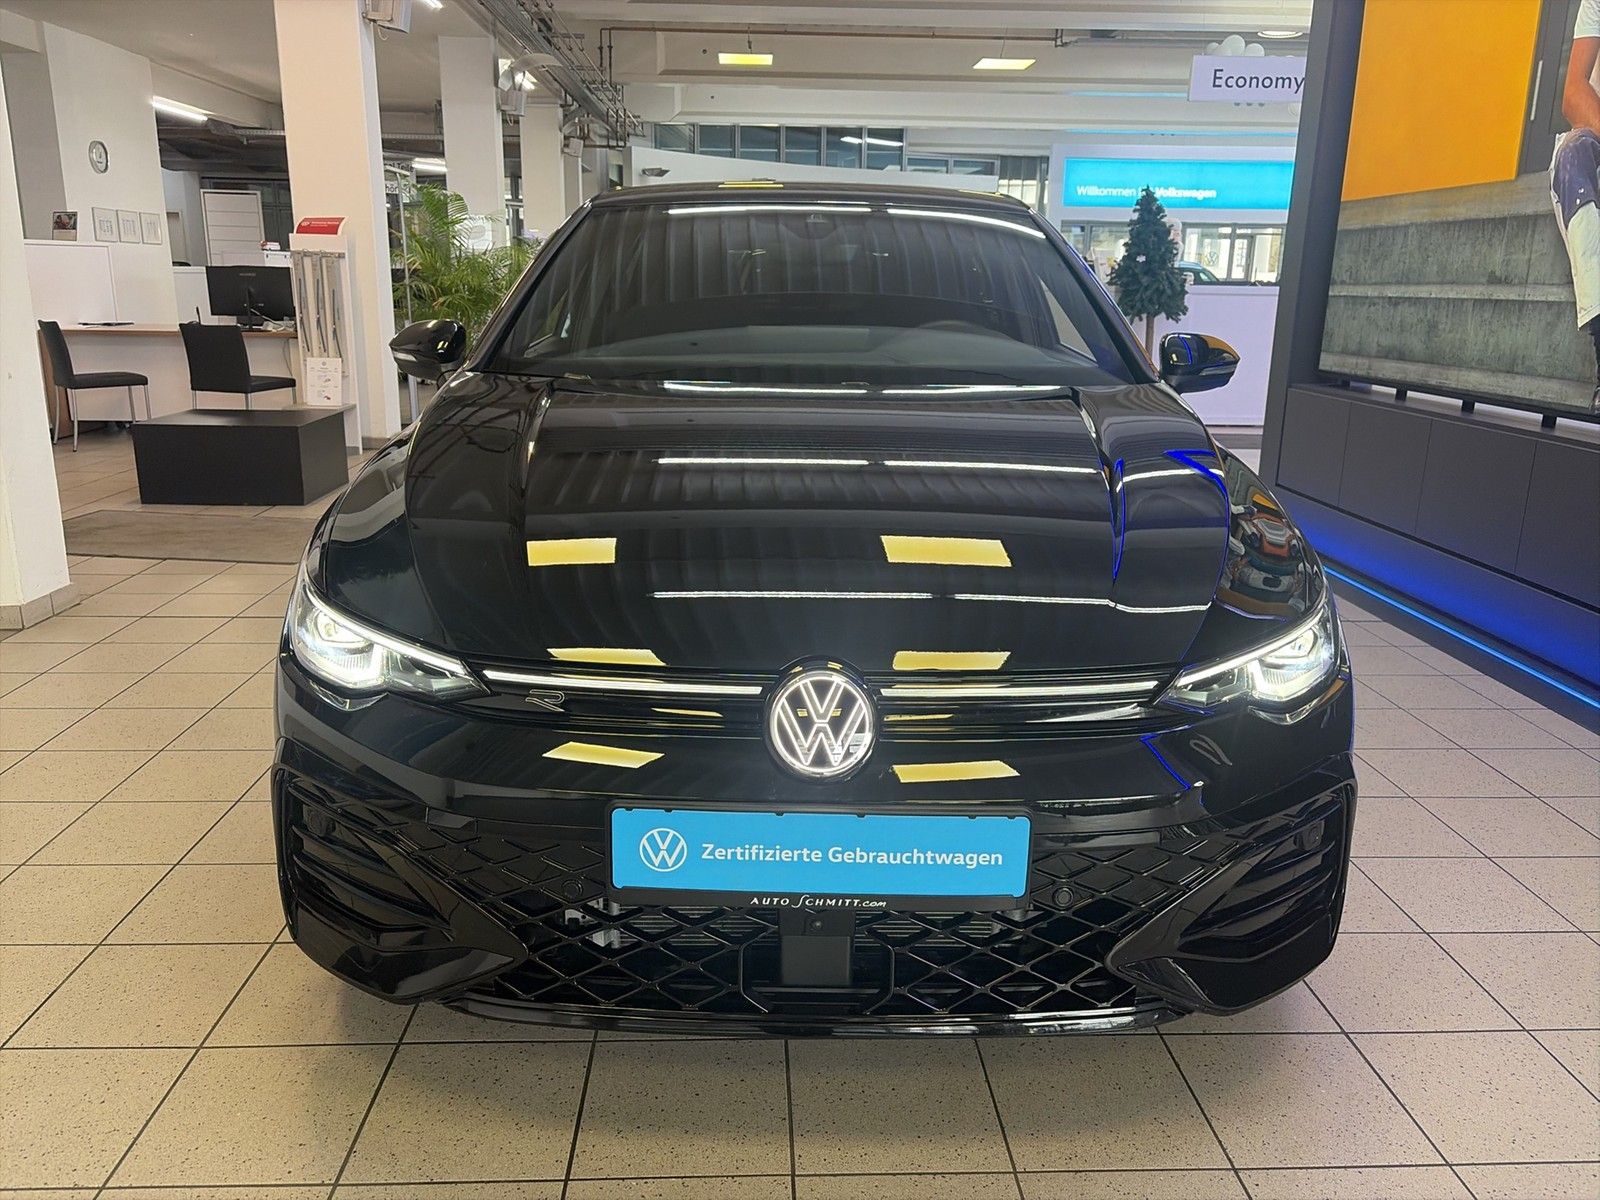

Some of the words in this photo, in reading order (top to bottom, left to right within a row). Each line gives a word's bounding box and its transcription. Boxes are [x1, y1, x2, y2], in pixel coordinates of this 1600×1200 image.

[1212, 68, 1305, 95] Economy
[1076, 185, 1136, 198] Willkommen
[1154, 187, 1217, 200] Volkswagen
[701, 843, 822, 863] Zertifizierte
[828, 846, 1003, 867] Gebrauchtwagen
[750, 897, 790, 906] AUTO
